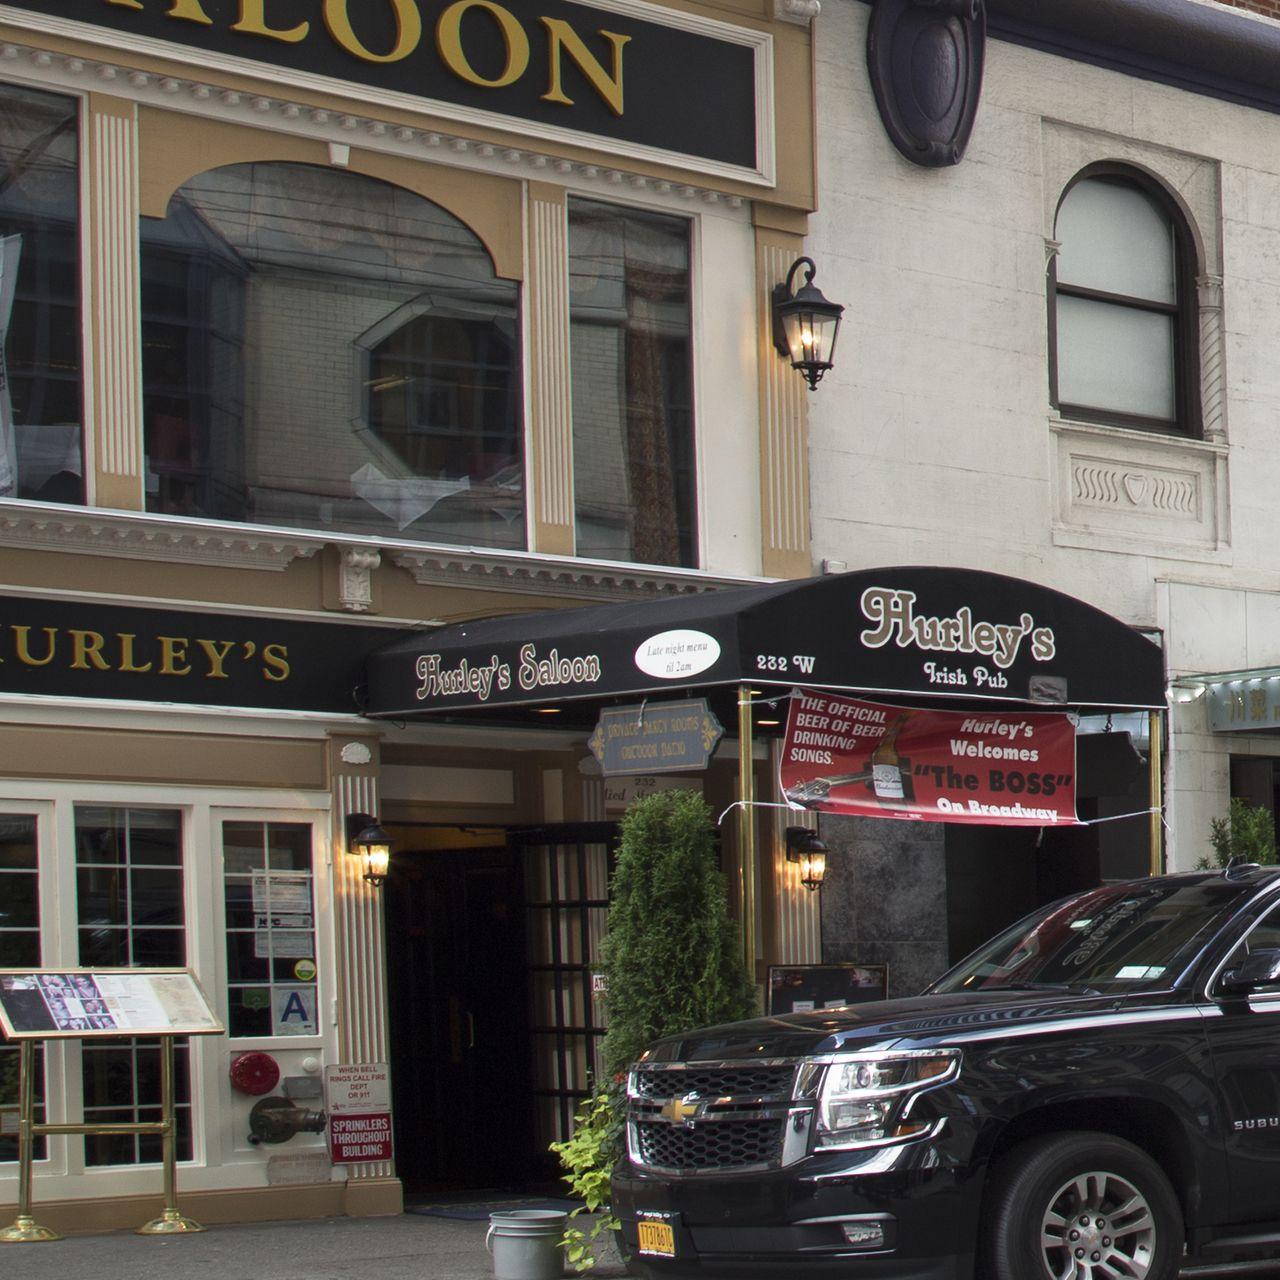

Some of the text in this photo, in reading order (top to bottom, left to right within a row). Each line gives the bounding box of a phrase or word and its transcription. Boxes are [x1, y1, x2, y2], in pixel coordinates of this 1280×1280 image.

[860, 586, 1057, 669] Hurley's
[0, 622, 291, 682] URLEY'S
[647, 642, 708, 657] Late night menu
[416, 642, 601, 701] Hurley's Saloon
[756, 654, 816, 675] 232 W
[923, 662, 1009, 690] Irish Pub
[800, 697, 887, 724] THE OFFICIAL
[796, 713, 886, 738] BEER OF BEER
[960, 718, 1034, 740] Hurley's
[793, 730, 856, 750] DRINKING
[950, 739, 1040, 762] Welcomes
[790, 748, 835, 765] SONGS.
[937, 797, 1058, 822] On Broadway
[280, 990, 310, 1023] A
[338, 1066, 359, 1074] WHEN
[372, 1073, 386, 1081] FIRE
[348, 1091, 359, 1099] OR
[333, 1118, 388, 1132] SPRINKLERS
[332, 1131, 390, 1145] THROUGHOUT
[342, 1144, 383, 1157] BUILDING
